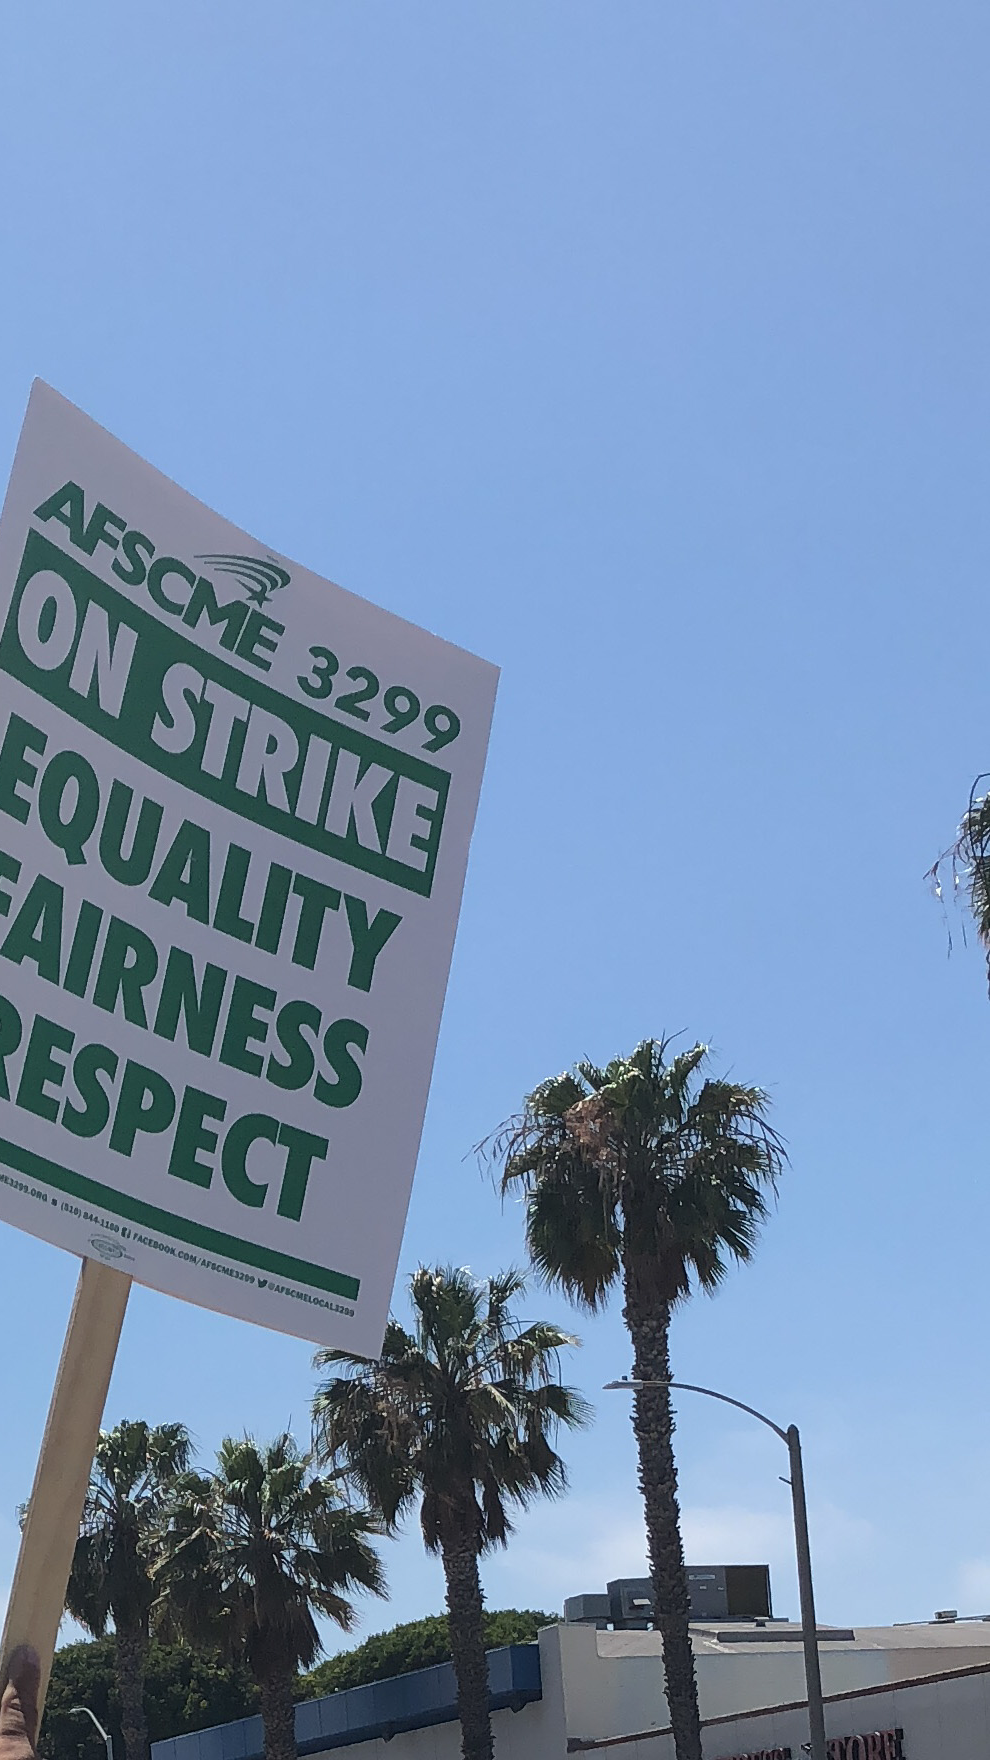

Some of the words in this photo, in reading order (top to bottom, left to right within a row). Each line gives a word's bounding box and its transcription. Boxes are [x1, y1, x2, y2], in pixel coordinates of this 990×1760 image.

[17, 569, 139, 719] ON
[151, 662, 439, 874] STRIKE
[33, 480, 285, 671] AFSCME
[296, 645, 461, 753] 3299
